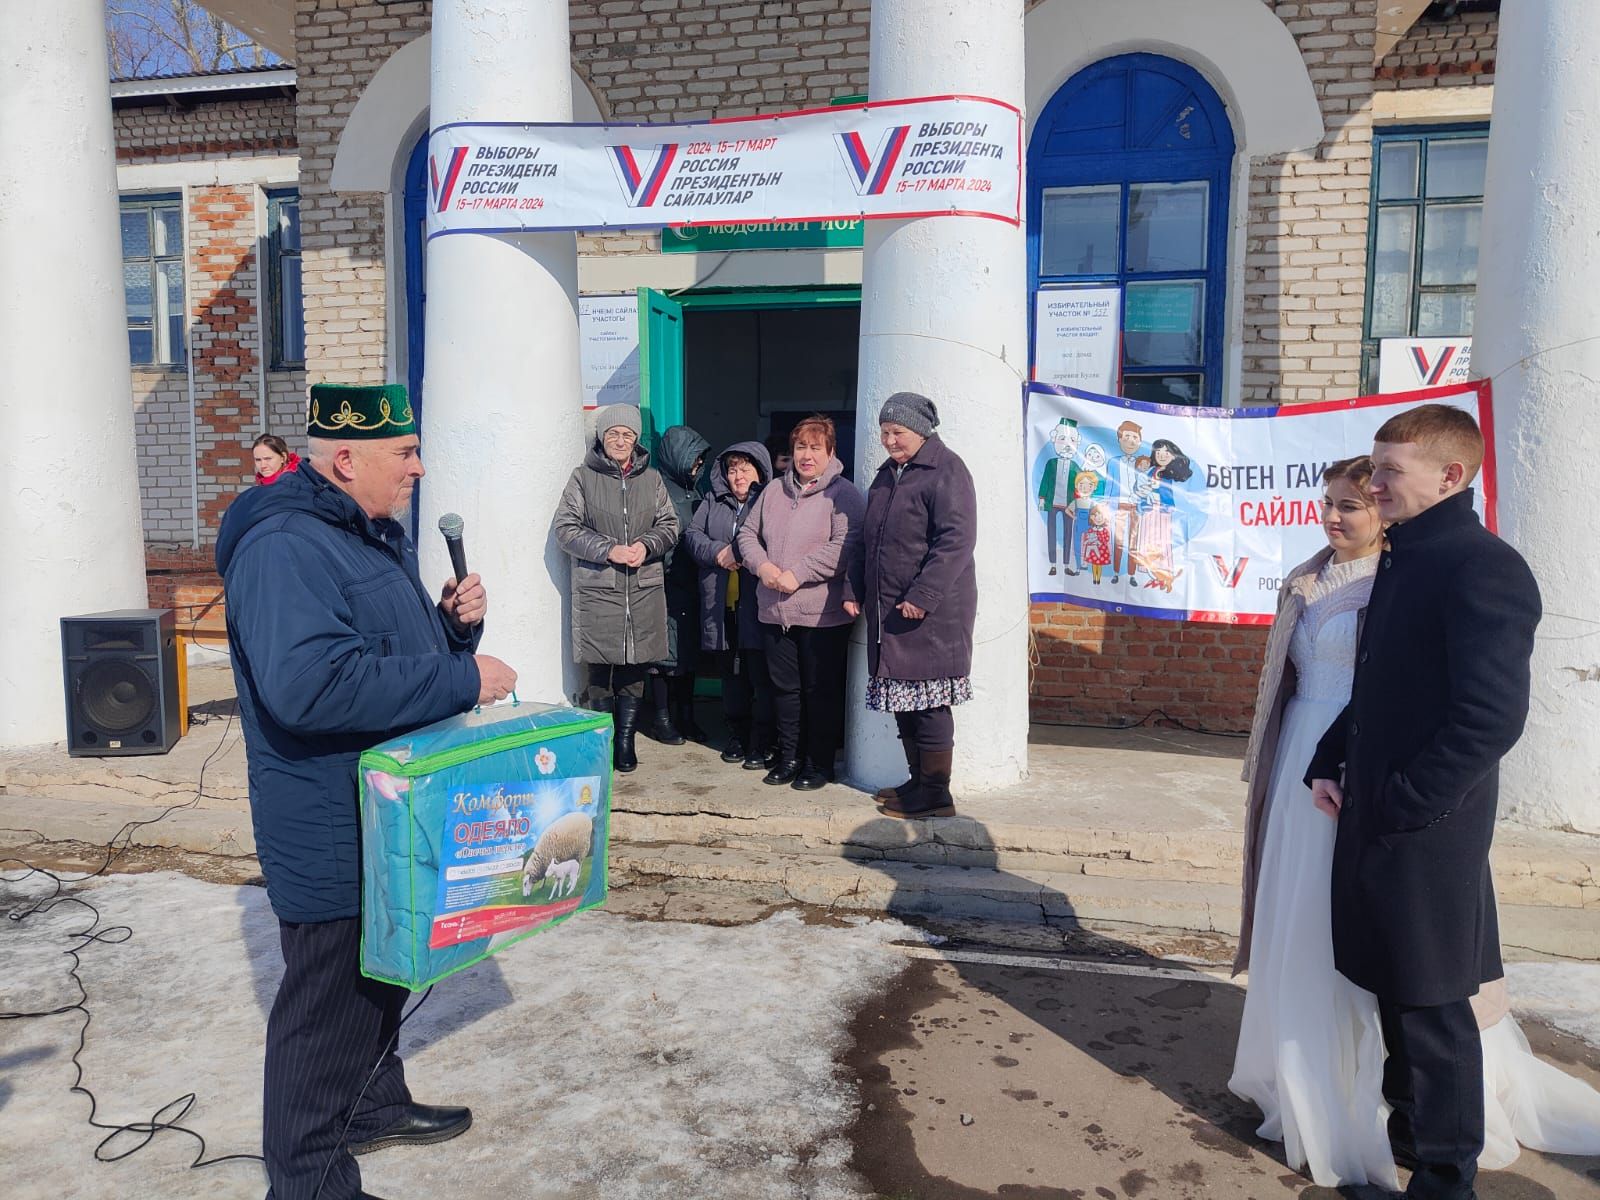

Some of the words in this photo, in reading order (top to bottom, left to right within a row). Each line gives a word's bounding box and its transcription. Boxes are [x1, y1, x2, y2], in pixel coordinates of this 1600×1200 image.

[918, 121, 988, 138] ВЫБОРЫ
[476, 146, 540, 160] ВЫБОРЫ
[686, 142, 712, 155] 2024
[746, 138, 778, 152] МАРТ
[910, 140, 1004, 160] ПРЕЗИДЕНТА
[468, 163, 558, 179] ПРЕЗИДЕНТА
[679, 157, 740, 173] РОССИЯ
[902, 160, 965, 177] РОССИИ
[461, 181, 519, 195] РОССИИ
[671, 172, 783, 190] ПРЕЗИДЕНТЫН
[927, 179, 967, 192] МАРТА
[966, 178, 992, 192] 2024
[483, 198, 518, 210] МАРТА
[519, 198, 545, 210] 2024
[663, 189, 753, 207] САЙЛАУЛАР
[615, 306, 638, 314] САЙЛА
[1047, 300, 1110, 309] ИЗБИРАТЕЛЬНЫЙ
[1048, 310, 1082, 318] УЧАСТОК
[1455, 356, 1470, 366] ПР
[1449, 368, 1469, 377] РОС
[1286, 461, 1337, 489] ГАИ
[1258, 577, 1285, 591] РОС
[454, 816, 531, 846] ОДЕЯЛО
